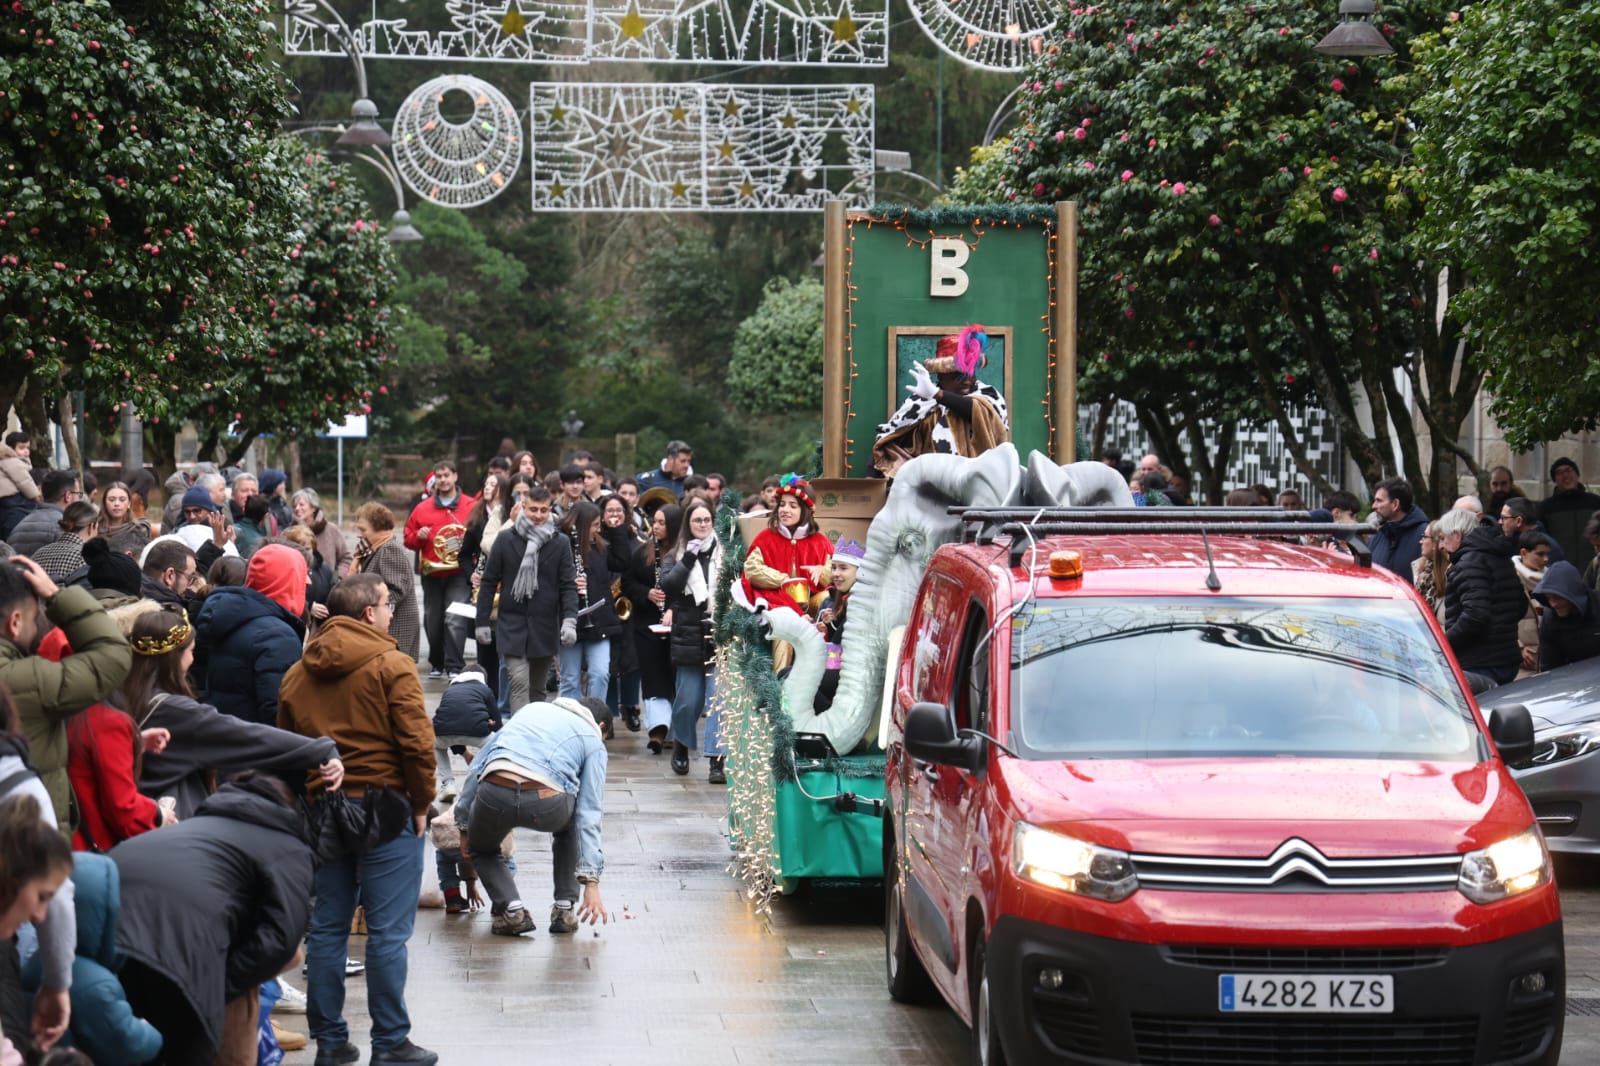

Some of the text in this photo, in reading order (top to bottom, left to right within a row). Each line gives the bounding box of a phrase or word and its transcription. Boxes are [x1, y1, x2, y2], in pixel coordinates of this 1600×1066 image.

[930, 238, 970, 297] B
[1241, 980, 1385, 1007] 4282 KZS
